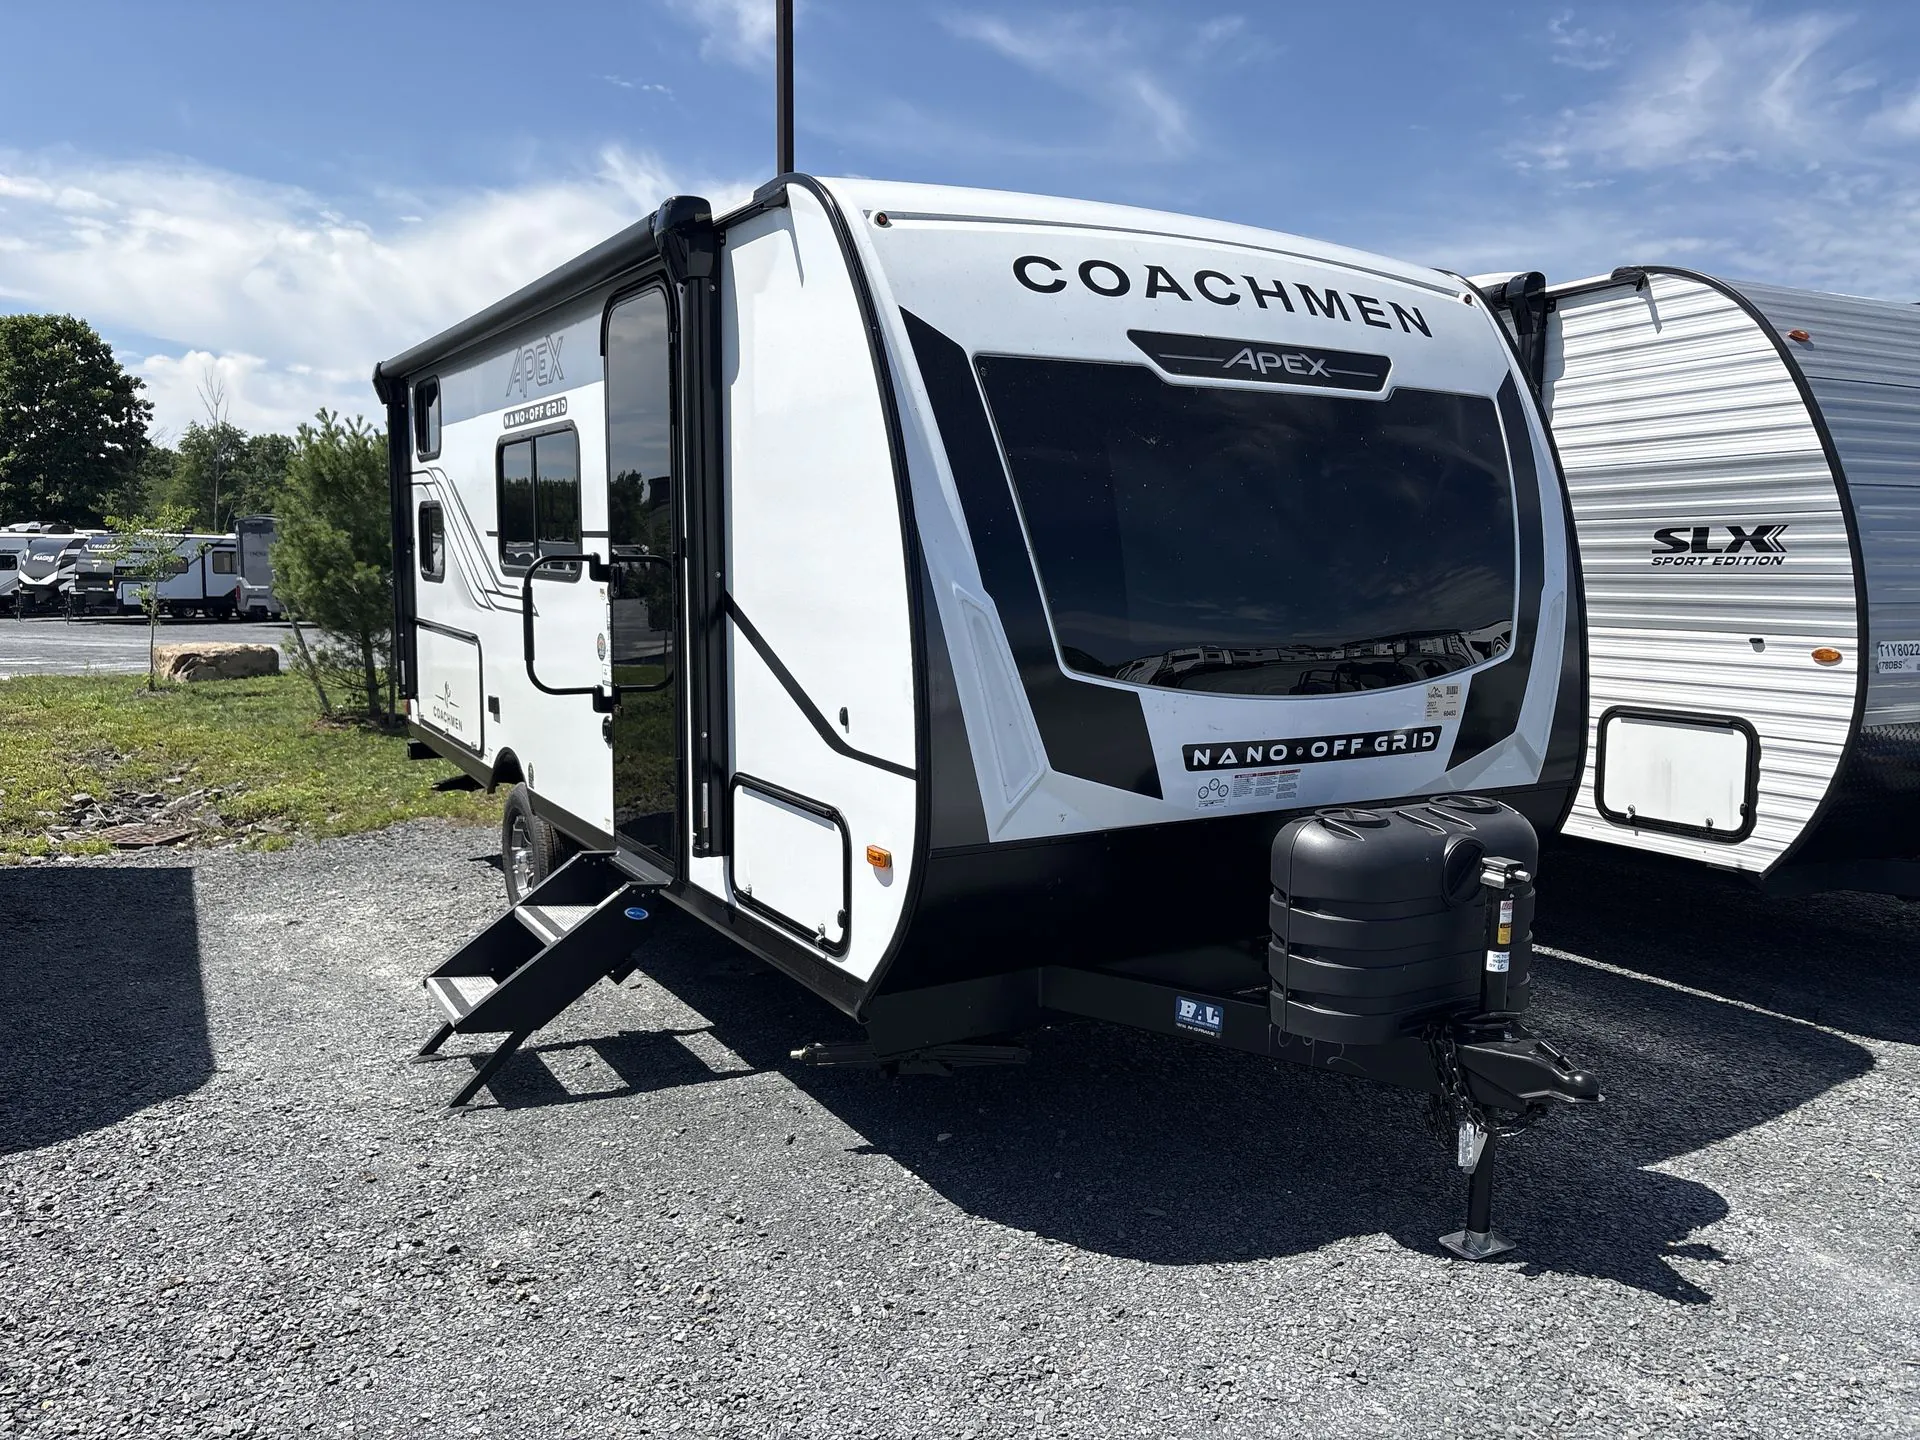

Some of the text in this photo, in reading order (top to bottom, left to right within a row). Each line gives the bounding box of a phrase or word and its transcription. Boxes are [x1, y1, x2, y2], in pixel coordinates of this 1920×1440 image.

[1013, 255, 1433, 338] COACHMEN
[505, 334, 565, 398] APEX
[1222, 347, 1332, 378] APEX
[504, 400, 567, 427] NANO OFF GRID
[1651, 524, 1789, 554] SLX
[1651, 556, 1785, 566] SPORT EDITION
[433, 705, 463, 732] COACHMEN
[1192, 731, 1436, 766] NANO OFF GRID
